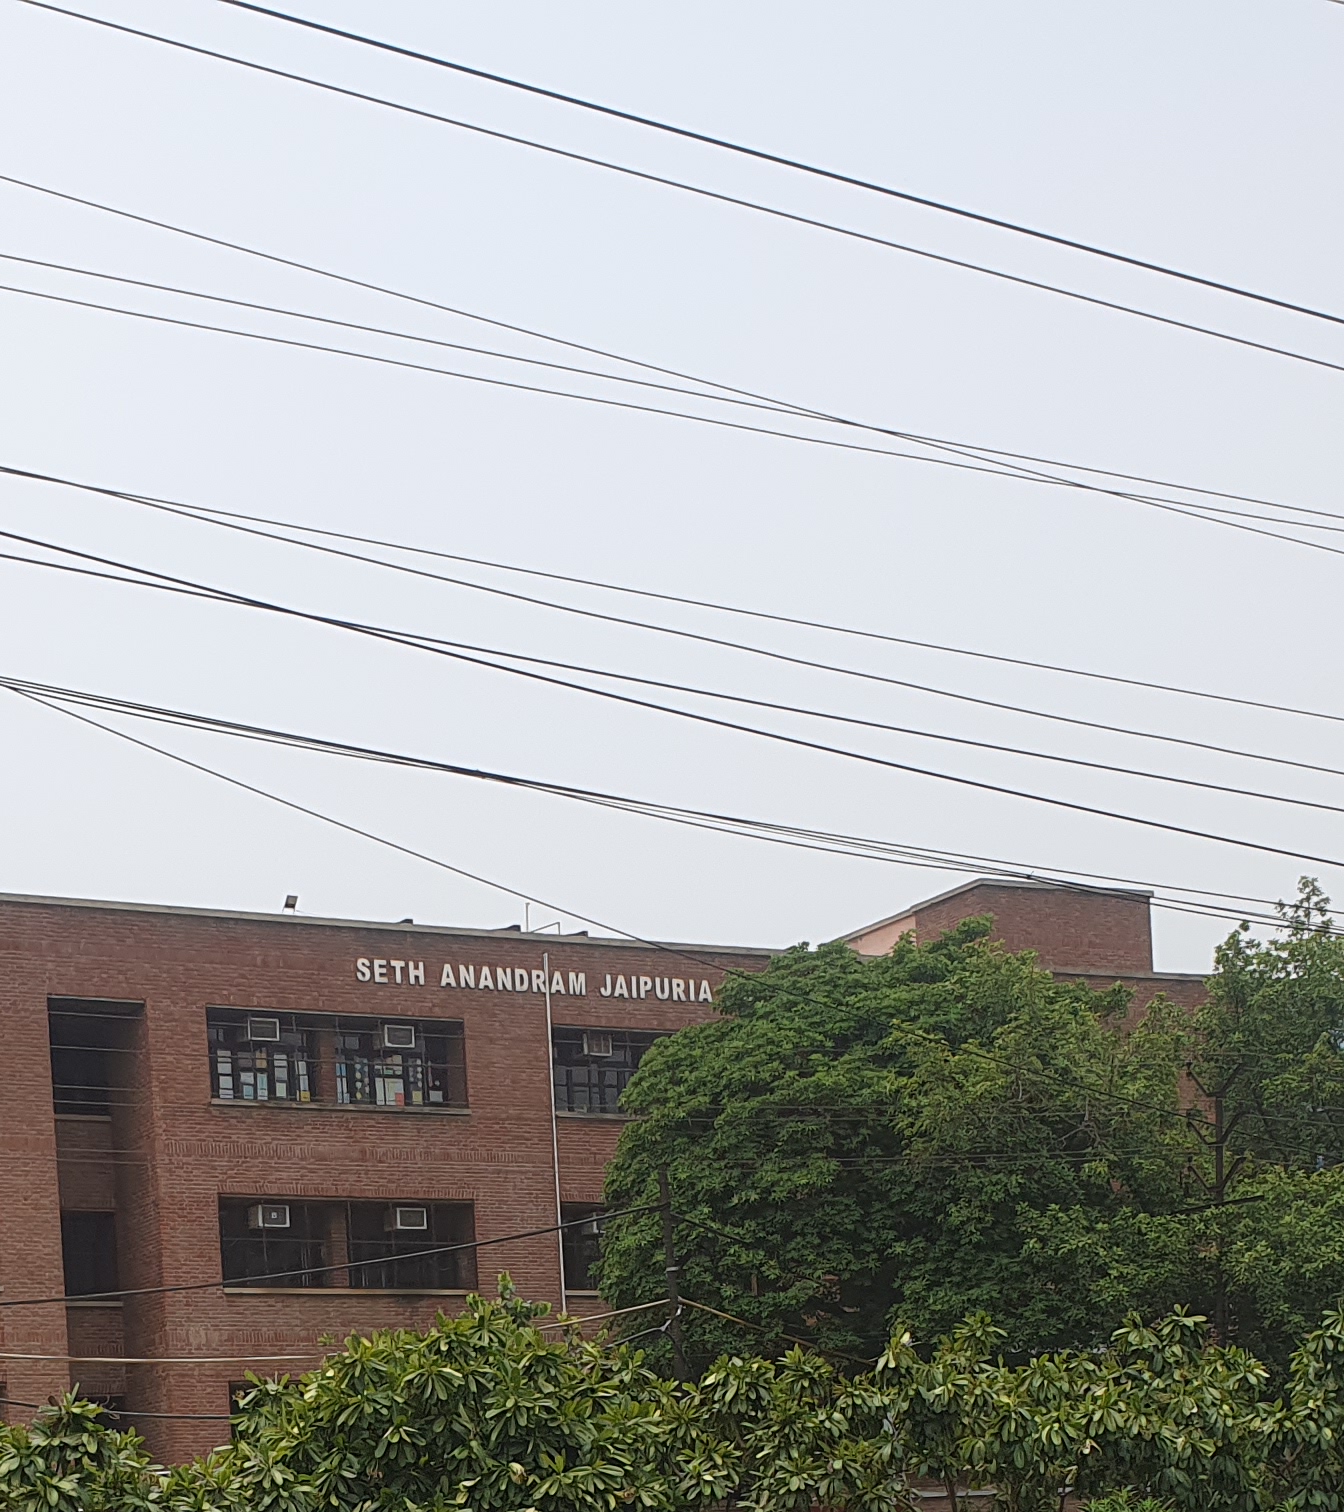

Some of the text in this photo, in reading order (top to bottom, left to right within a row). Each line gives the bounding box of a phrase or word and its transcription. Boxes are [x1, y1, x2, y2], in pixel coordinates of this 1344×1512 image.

[356, 957, 713, 1003] SETH ANANDRAM JAIPURIA
